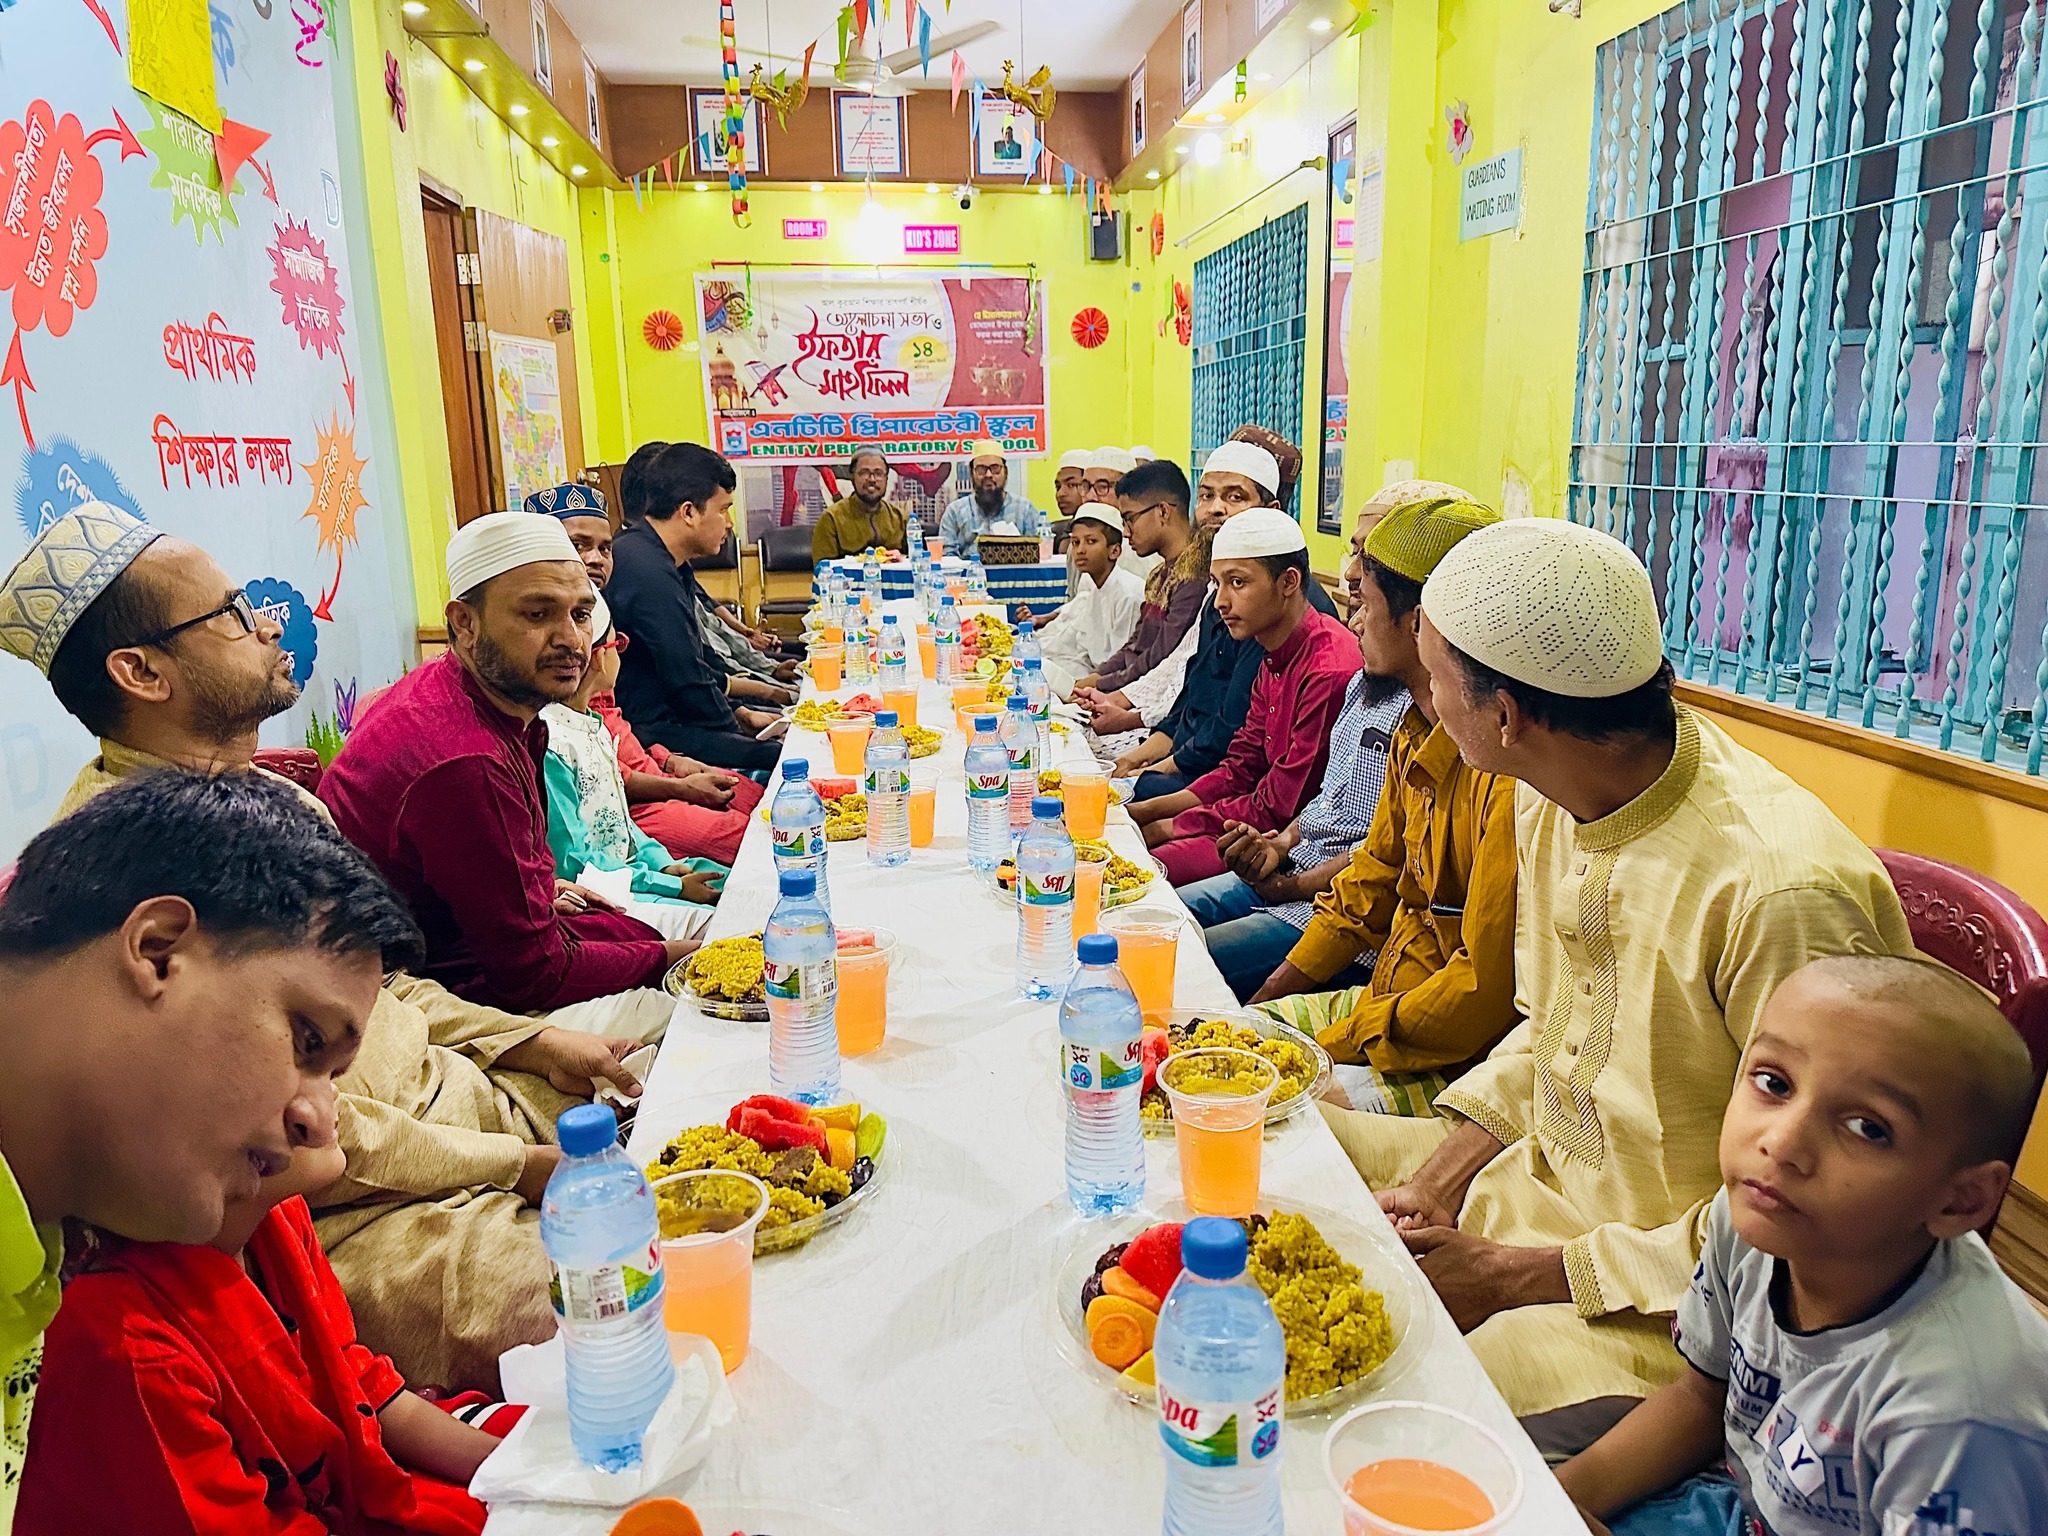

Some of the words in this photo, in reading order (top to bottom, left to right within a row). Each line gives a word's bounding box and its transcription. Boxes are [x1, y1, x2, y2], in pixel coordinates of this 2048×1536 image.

[3, 113, 48, 239] সৃজনশীলতা
[40, 148, 75, 231] জীবনের
[1467, 157, 1506, 189] GUARDIANS
[1465, 197, 1495, 222] WAITING
[1496, 191, 1516, 215] ROOM
[786, 221, 825, 237] ROOM-11
[905, 230, 932, 249] KID'S
[932, 229, 957, 249] ZONE
[280, 244, 326, 286] সামাজিক
[294, 291, 331, 333] নৈতিক
[826, 312, 896, 336] আলোচনা
[897, 312, 934, 330] সভা
[932, 318, 942, 330] ও
[162, 310, 257, 385] প্রাথমিক
[792, 305, 889, 388] ইফতার
[912, 341, 933, 358] ১৪
[817, 361, 911, 401] মাহফিল
[749, 414, 845, 438] এনটিটি
[850, 412, 981, 438] প্রিপারেটরী
[985, 415, 1036, 437] স্কুল
[151, 412, 241, 492] শিক্ষার
[241, 437, 293, 486] লক্ষ্য
[751, 443, 820, 457] ENTITY
[963, 439, 1038, 451] SOOL
[316, 439, 340, 512] মানবিক
[978, 774, 1001, 789] Spa
[772, 826, 789, 843] Spa
[1159, 1384, 1202, 1431] Spa
